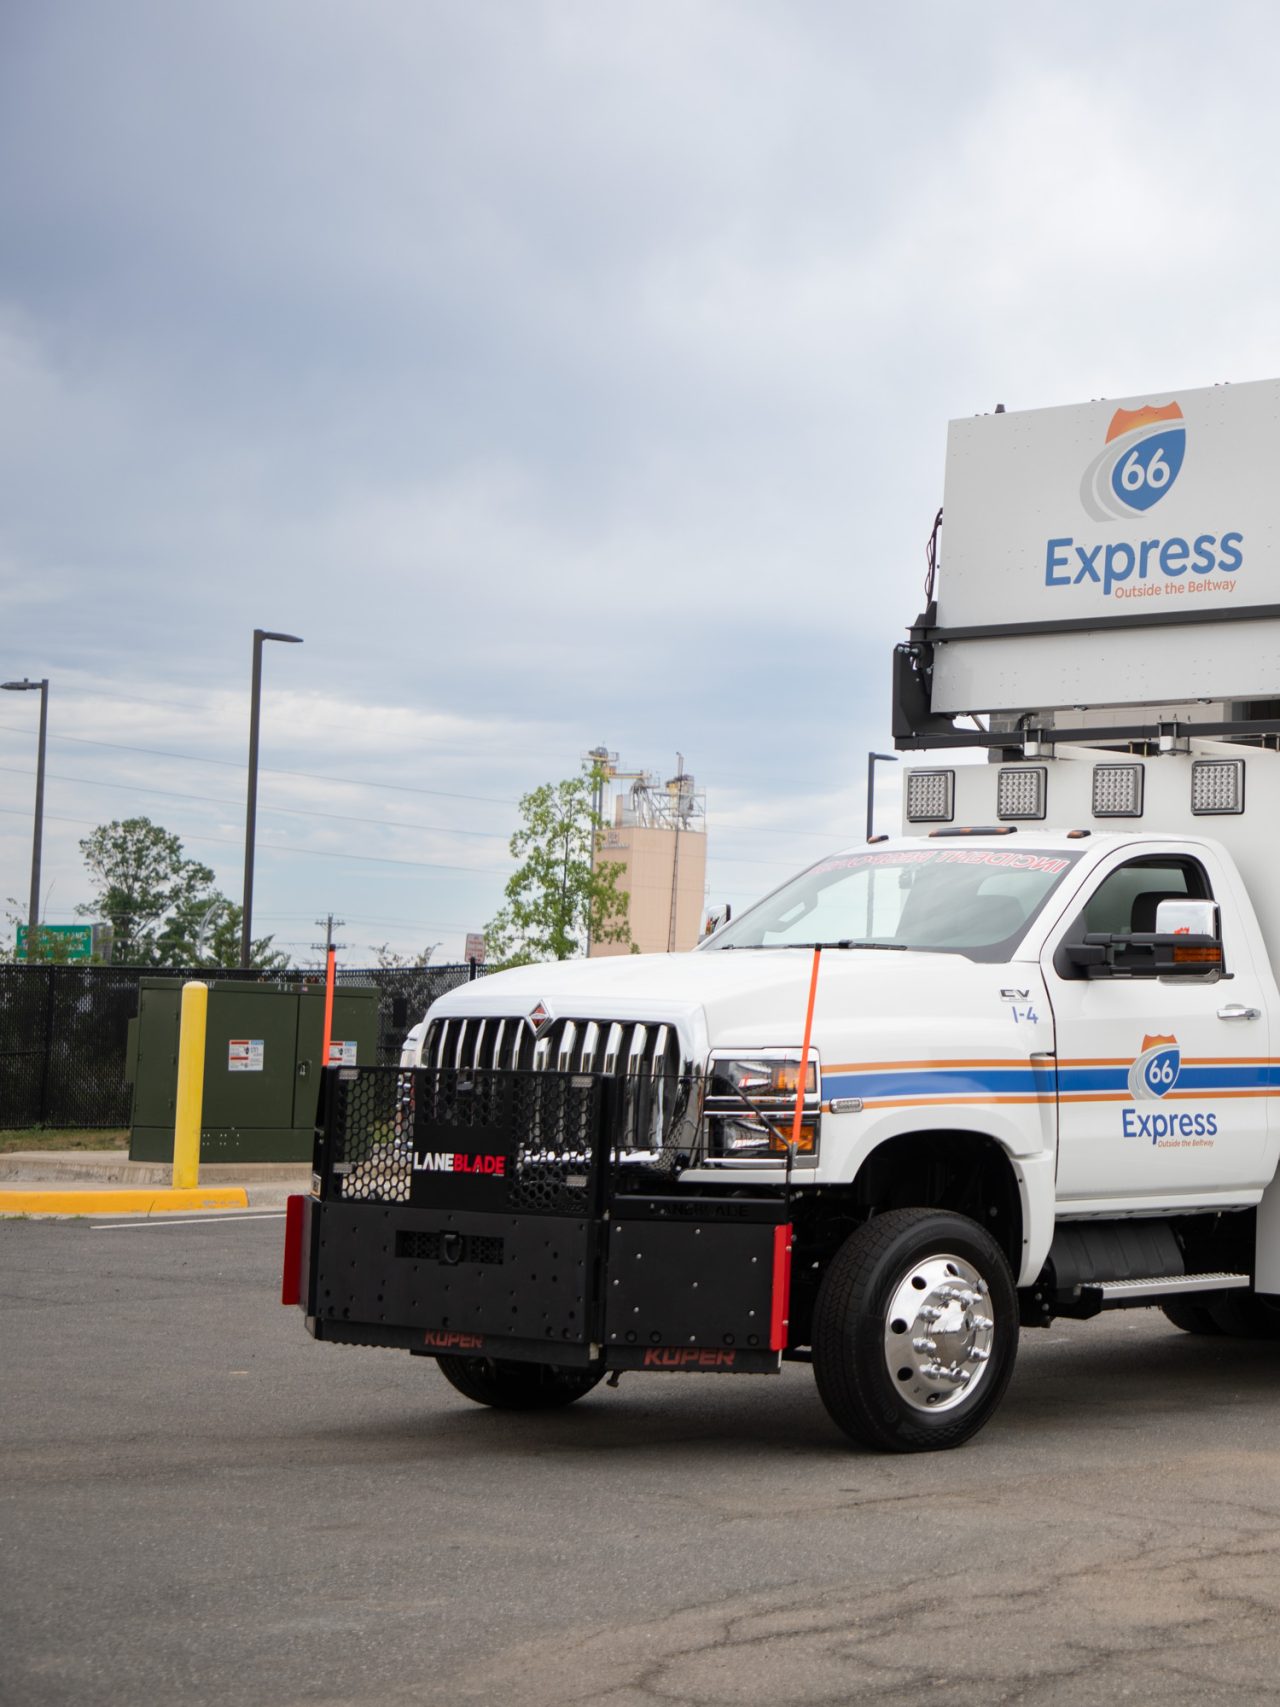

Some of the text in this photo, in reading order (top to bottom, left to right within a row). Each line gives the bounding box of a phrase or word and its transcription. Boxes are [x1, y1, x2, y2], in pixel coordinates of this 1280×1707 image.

[1121, 448, 1171, 491] 66
[1045, 532, 1244, 595] Express
[1114, 579, 1236, 599] Outside the Beltway
[1149, 1059, 1173, 1084] 66
[1122, 1109, 1218, 1145] Express
[1158, 1138, 1214, 1148] Outside the Beltway
[413, 1151, 507, 1174] LANEBLADE
